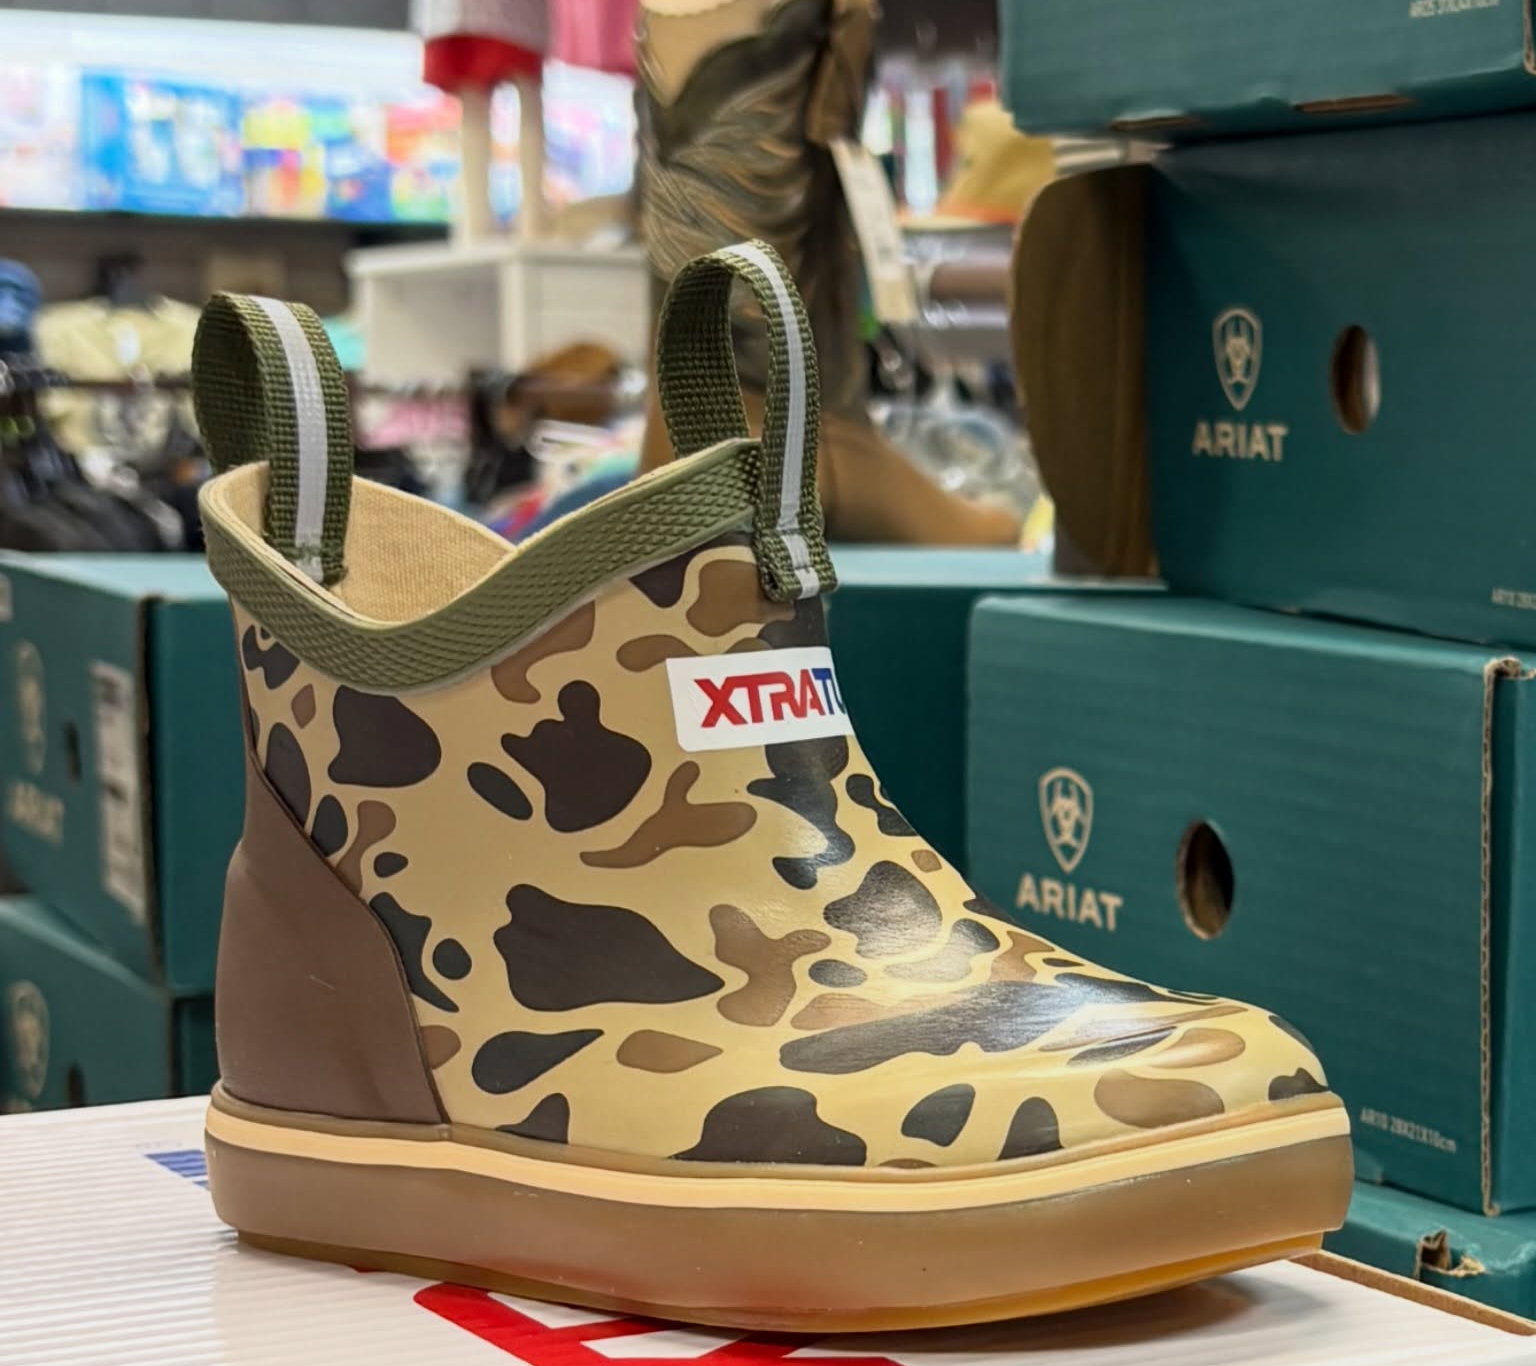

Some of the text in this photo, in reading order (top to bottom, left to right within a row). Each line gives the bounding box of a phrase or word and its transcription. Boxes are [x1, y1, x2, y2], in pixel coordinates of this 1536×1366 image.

[1192, 421, 1288, 462] ARIAT
[694, 667, 847, 729] XTRAT
[1016, 873, 1124, 931] ARIAT
